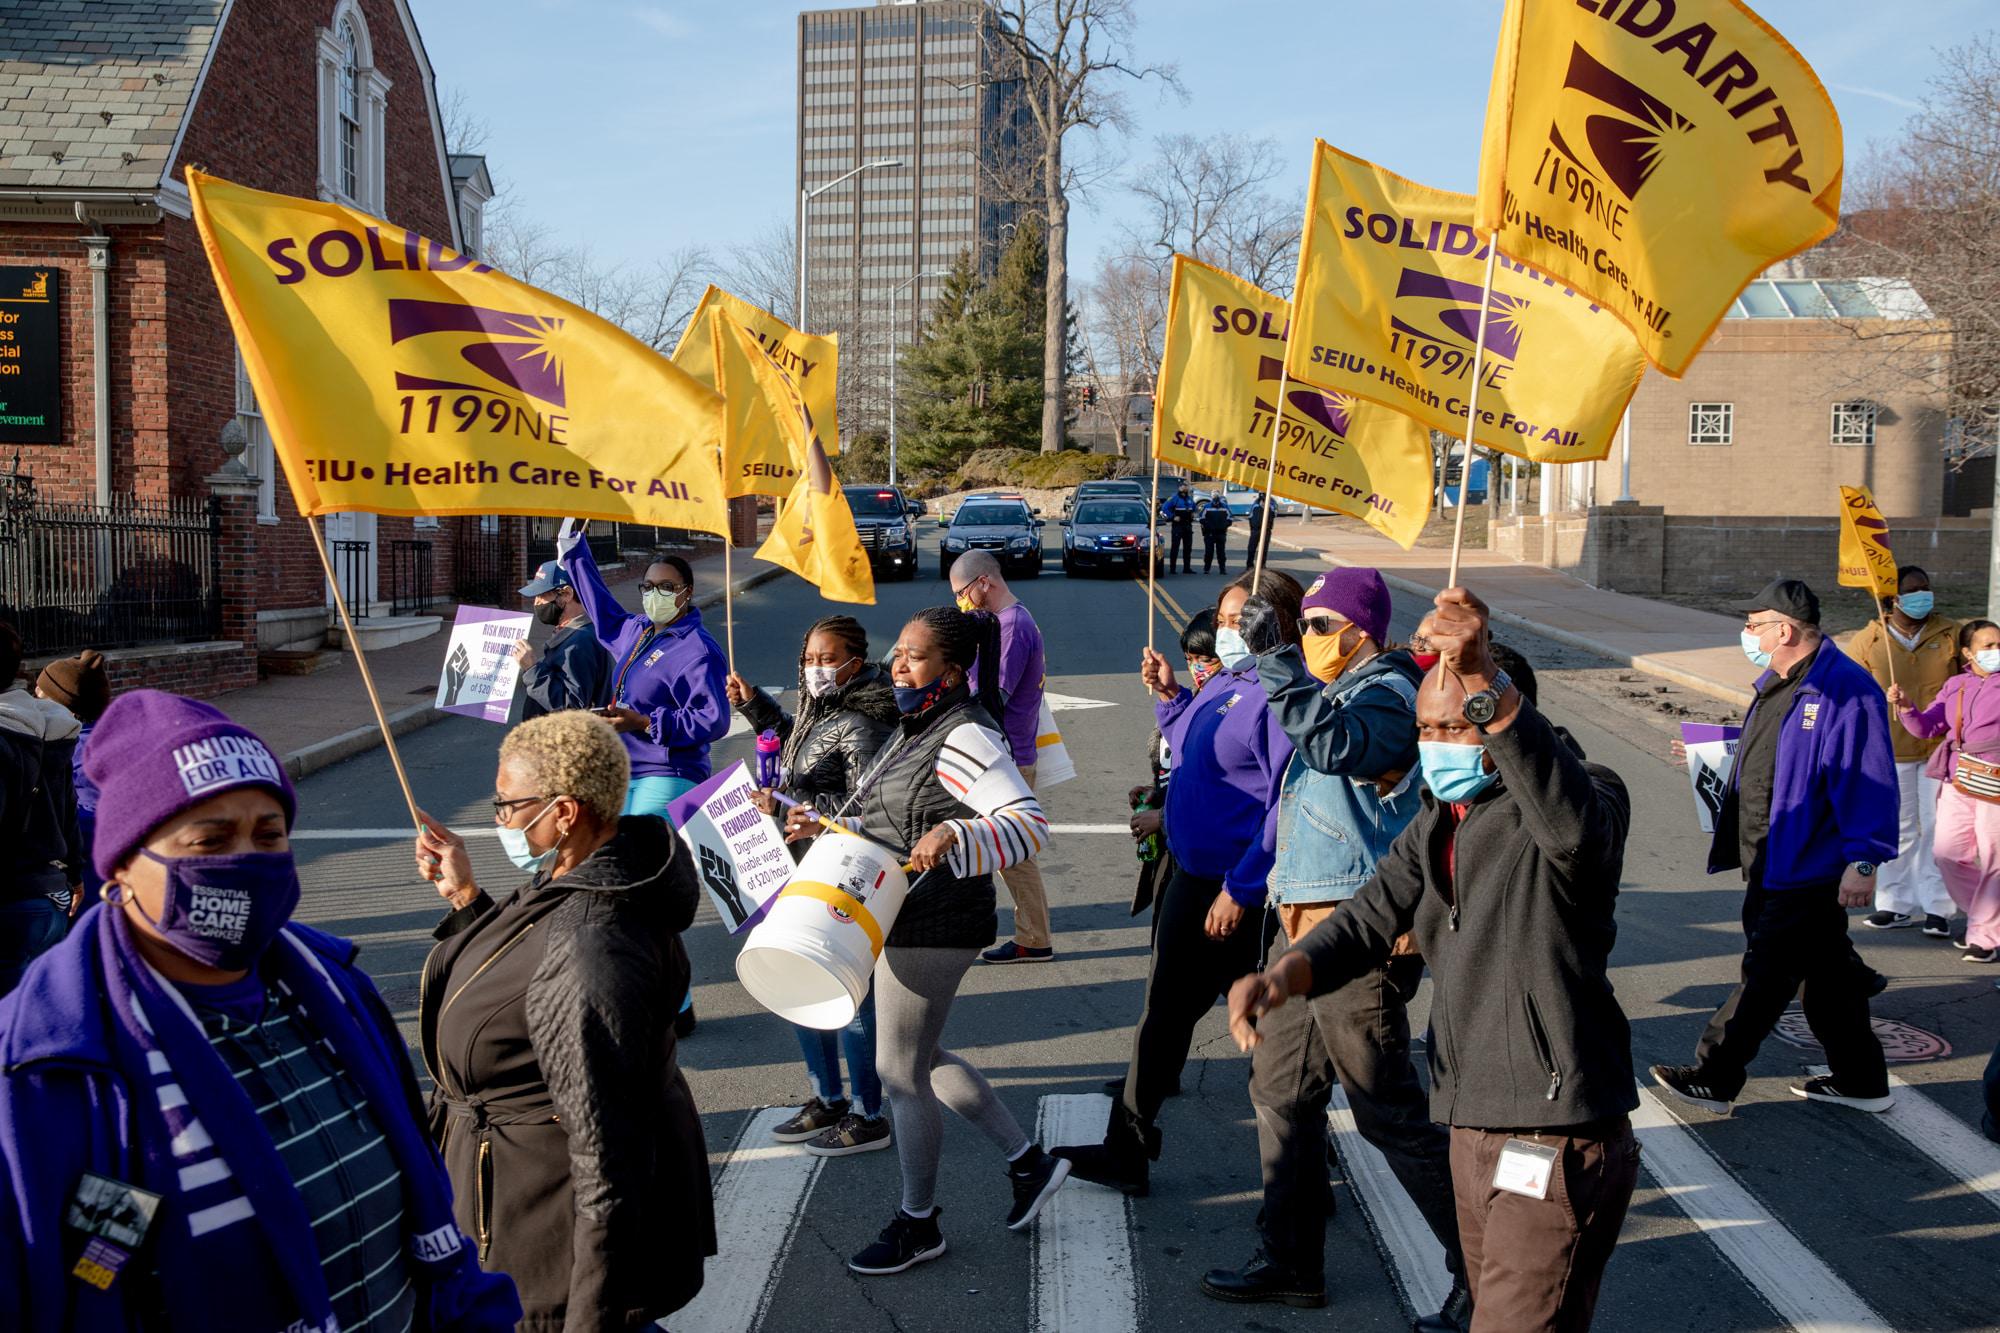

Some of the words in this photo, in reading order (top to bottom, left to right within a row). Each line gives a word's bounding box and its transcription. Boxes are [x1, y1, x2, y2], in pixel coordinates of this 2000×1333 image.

[1534, 148, 1628, 241] 1199NE
[1526, 211, 1588, 266] Health
[1594, 248, 1628, 291] Care
[1644, 300, 1671, 332] All
[0, 310, 19, 323] for
[1311, 346, 1365, 373] SEIU
[1380, 365, 1439, 408] Health
[1500, 412, 1538, 437] For
[1541, 428, 1578, 446] All
[400, 395, 569, 445] 1199NE
[385, 461, 498, 485] Health
[509, 461, 580, 487] Care
[589, 469, 637, 494] For
[648, 478, 690, 500] All
[742, 463, 784, 478] SEIU
[1172, 431, 1219, 455] SEIU
[1289, 465, 1326, 488] Care
[1331, 477, 1362, 498] For
[1363, 493, 1393, 513] All
[482, 624, 498, 637] RISK
[498, 625, 516, 639] MUST
[173, 736, 272, 771] UNIONS
[186, 760, 230, 786] FOR
[237, 758, 281, 783] ALL
[706, 797, 728, 820] RISK
[722, 787, 746, 811] MUST
[721, 806, 762, 839] REWARDED
[733, 830, 769, 855] Dignified
[736, 856, 762, 874] livable
[761, 847, 783, 862] wage
[192, 884, 251, 899] ESSENTIAL
[747, 877, 757, 890] of
[190, 895, 252, 915] HOME
[188, 910, 248, 931] CARE
